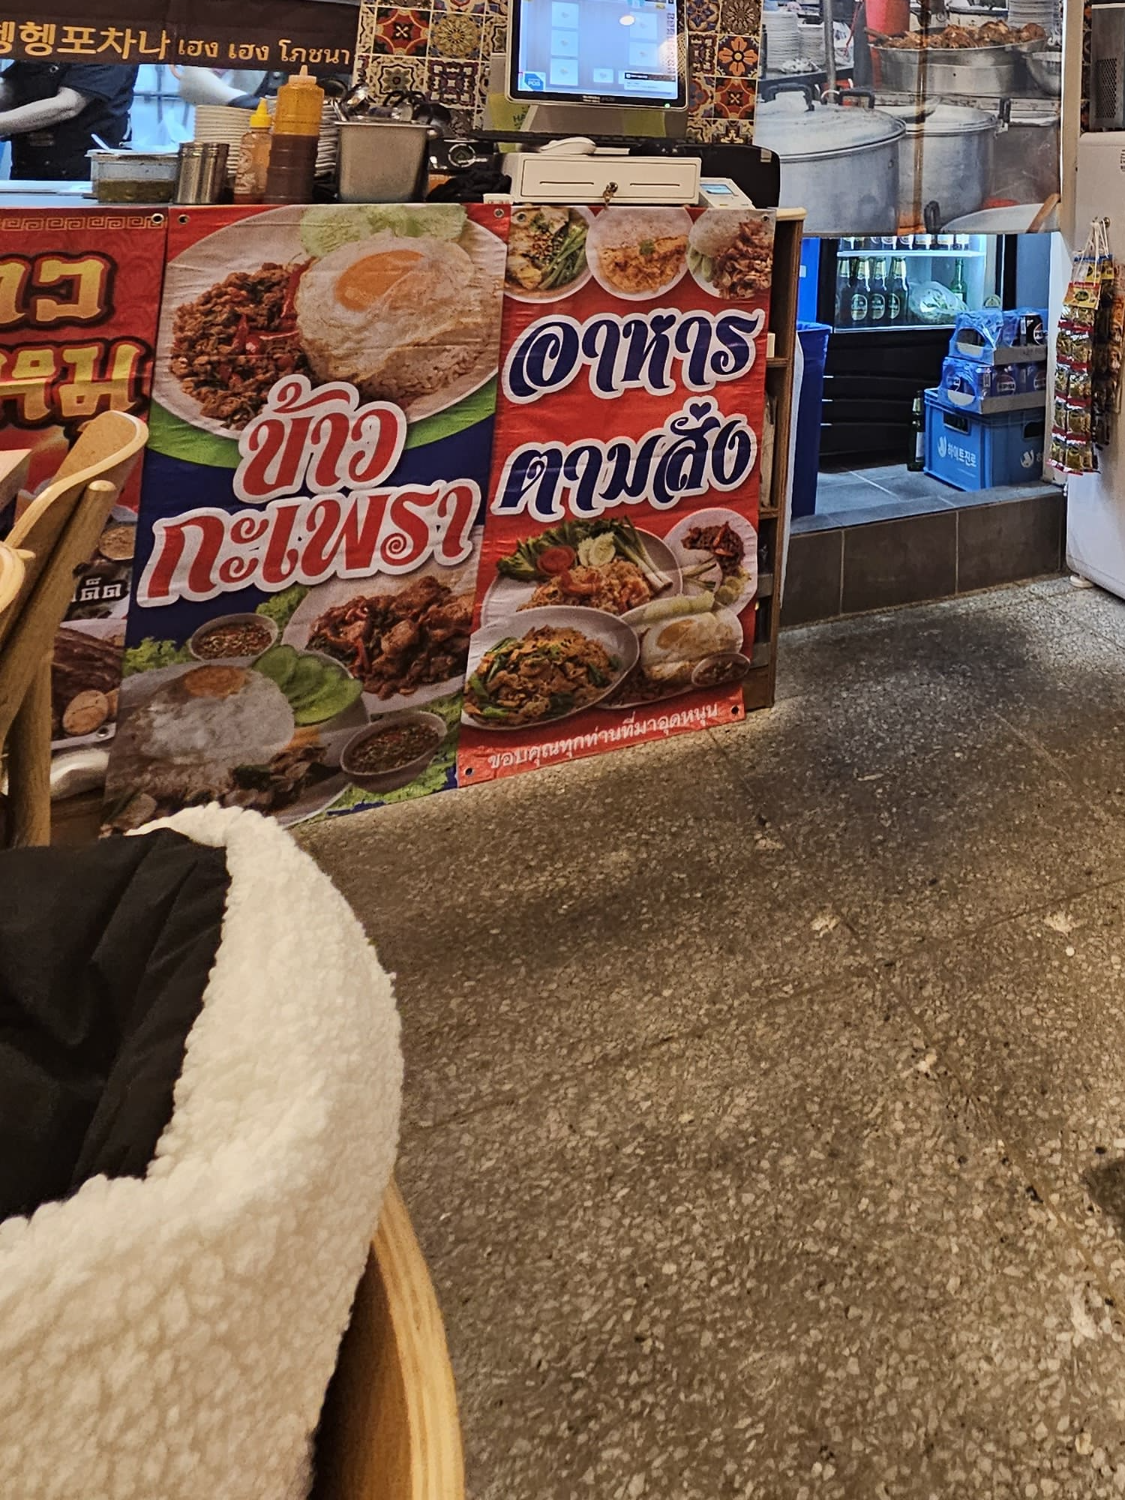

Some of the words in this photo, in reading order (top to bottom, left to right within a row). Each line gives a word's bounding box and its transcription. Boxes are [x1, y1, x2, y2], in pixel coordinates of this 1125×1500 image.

[178, 39, 219, 58] เฮง
[228, 42, 270, 61] เฮง
[278, 39, 351, 65] โภชนา
[507, 312, 761, 399] อาหาร
[240, 379, 401, 499] ข้าว
[496, 401, 753, 515] ตามสั่ง
[947, 442, 978, 468] 하이트진로
[144, 483, 476, 601] กะเพรา
[487, 702, 719, 768] ขอบคุณทุกท่านที่มาอุดหนุน
